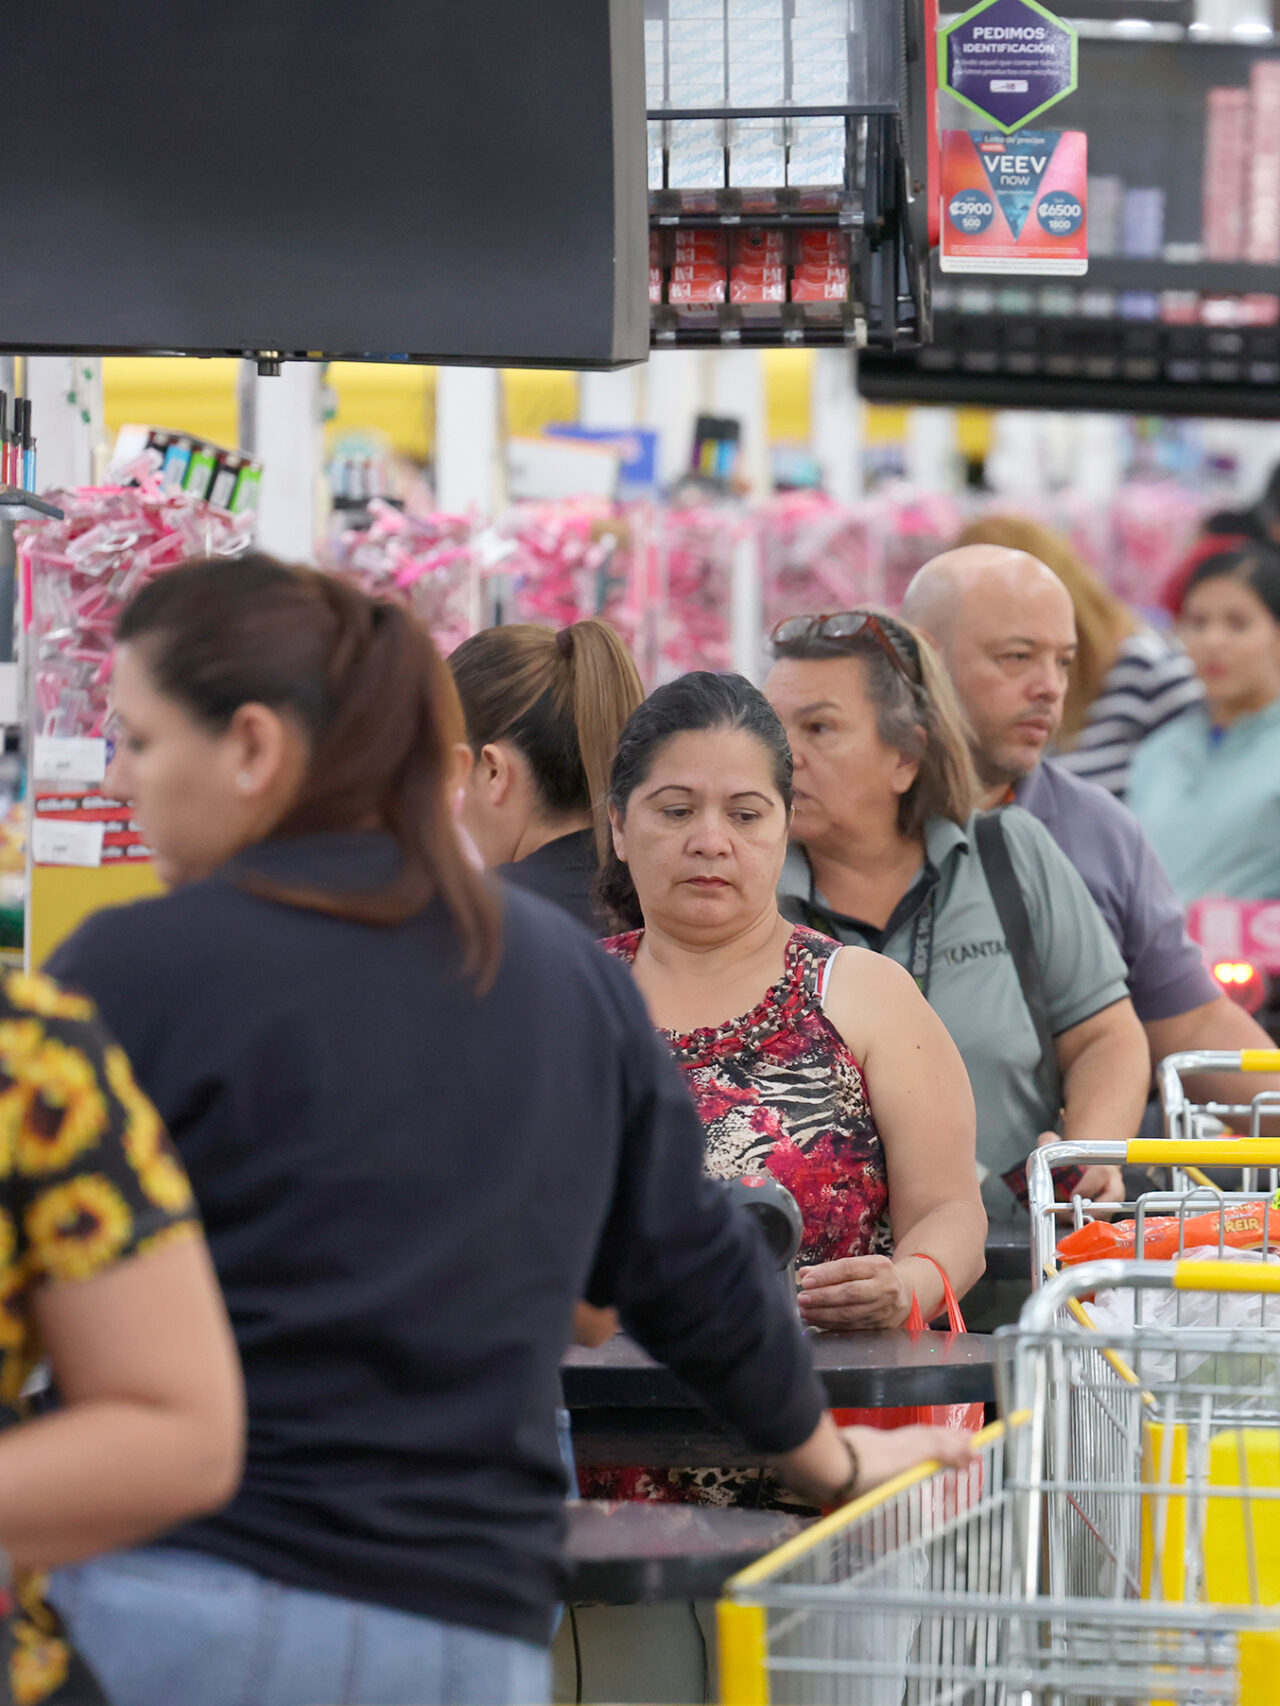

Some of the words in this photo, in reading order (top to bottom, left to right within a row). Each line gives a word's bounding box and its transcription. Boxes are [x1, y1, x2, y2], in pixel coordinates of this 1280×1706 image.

[973, 27, 1045, 40] PEDIMOS
[983, 155, 1047, 174] VEEV
[1000, 175, 1030, 185] now
[962, 218, 982, 228] 500
[943, 940, 1006, 966] KANTA
